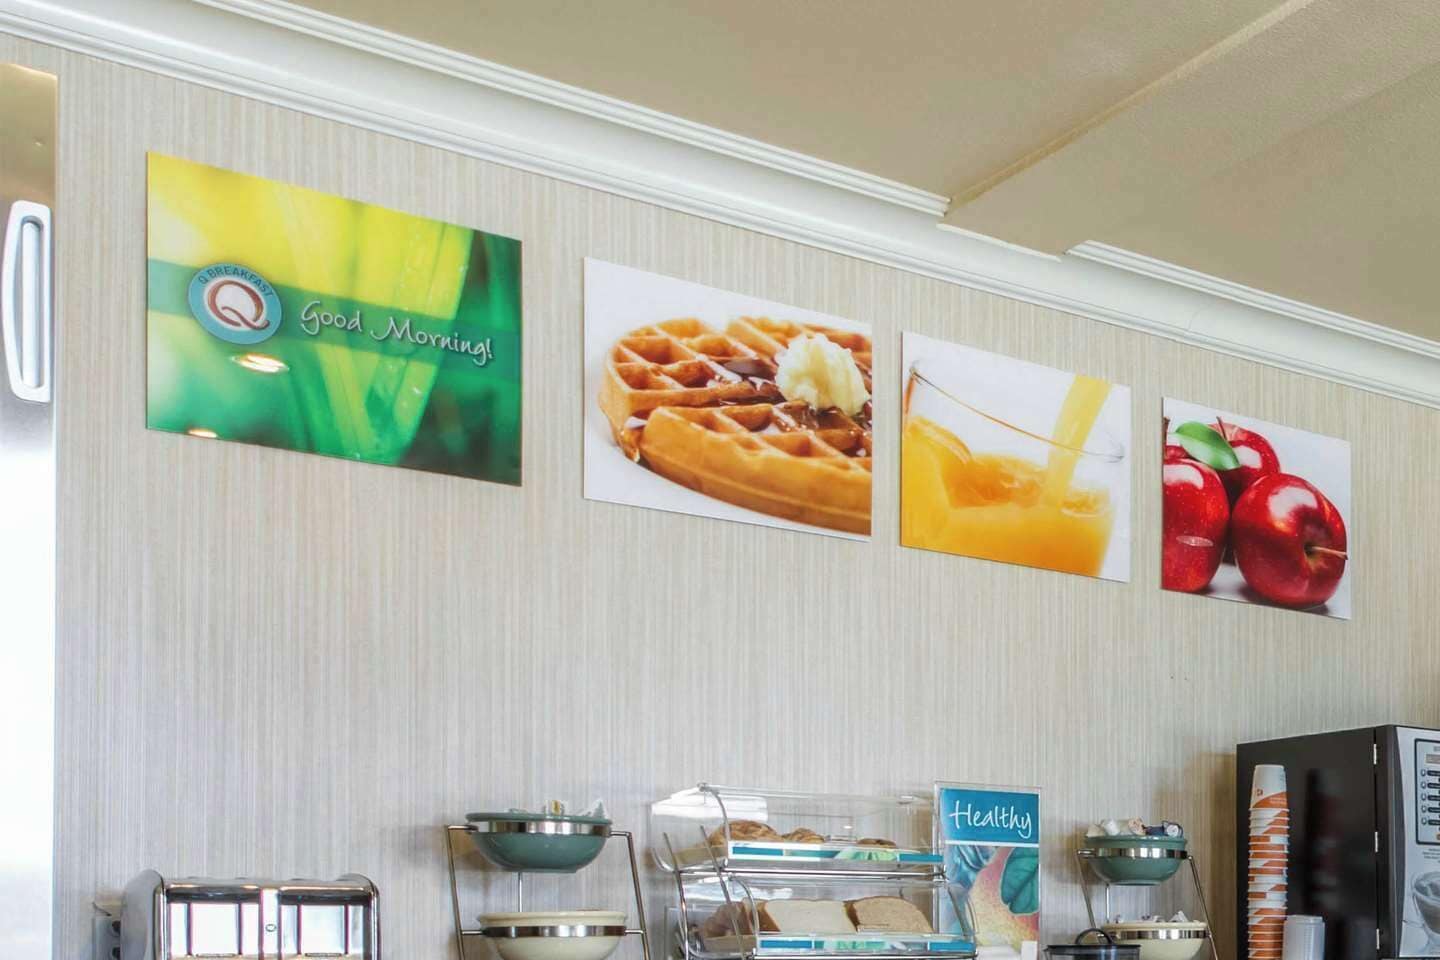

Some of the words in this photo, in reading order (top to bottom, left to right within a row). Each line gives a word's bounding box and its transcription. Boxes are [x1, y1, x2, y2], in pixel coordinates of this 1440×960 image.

[207, 265, 274, 297] BREAKFAST
[207, 280, 270, 330] Q
[300, 300, 362, 336] Good
[370, 316, 493, 366] Morning!
[949, 800, 1032, 840] Healthy
